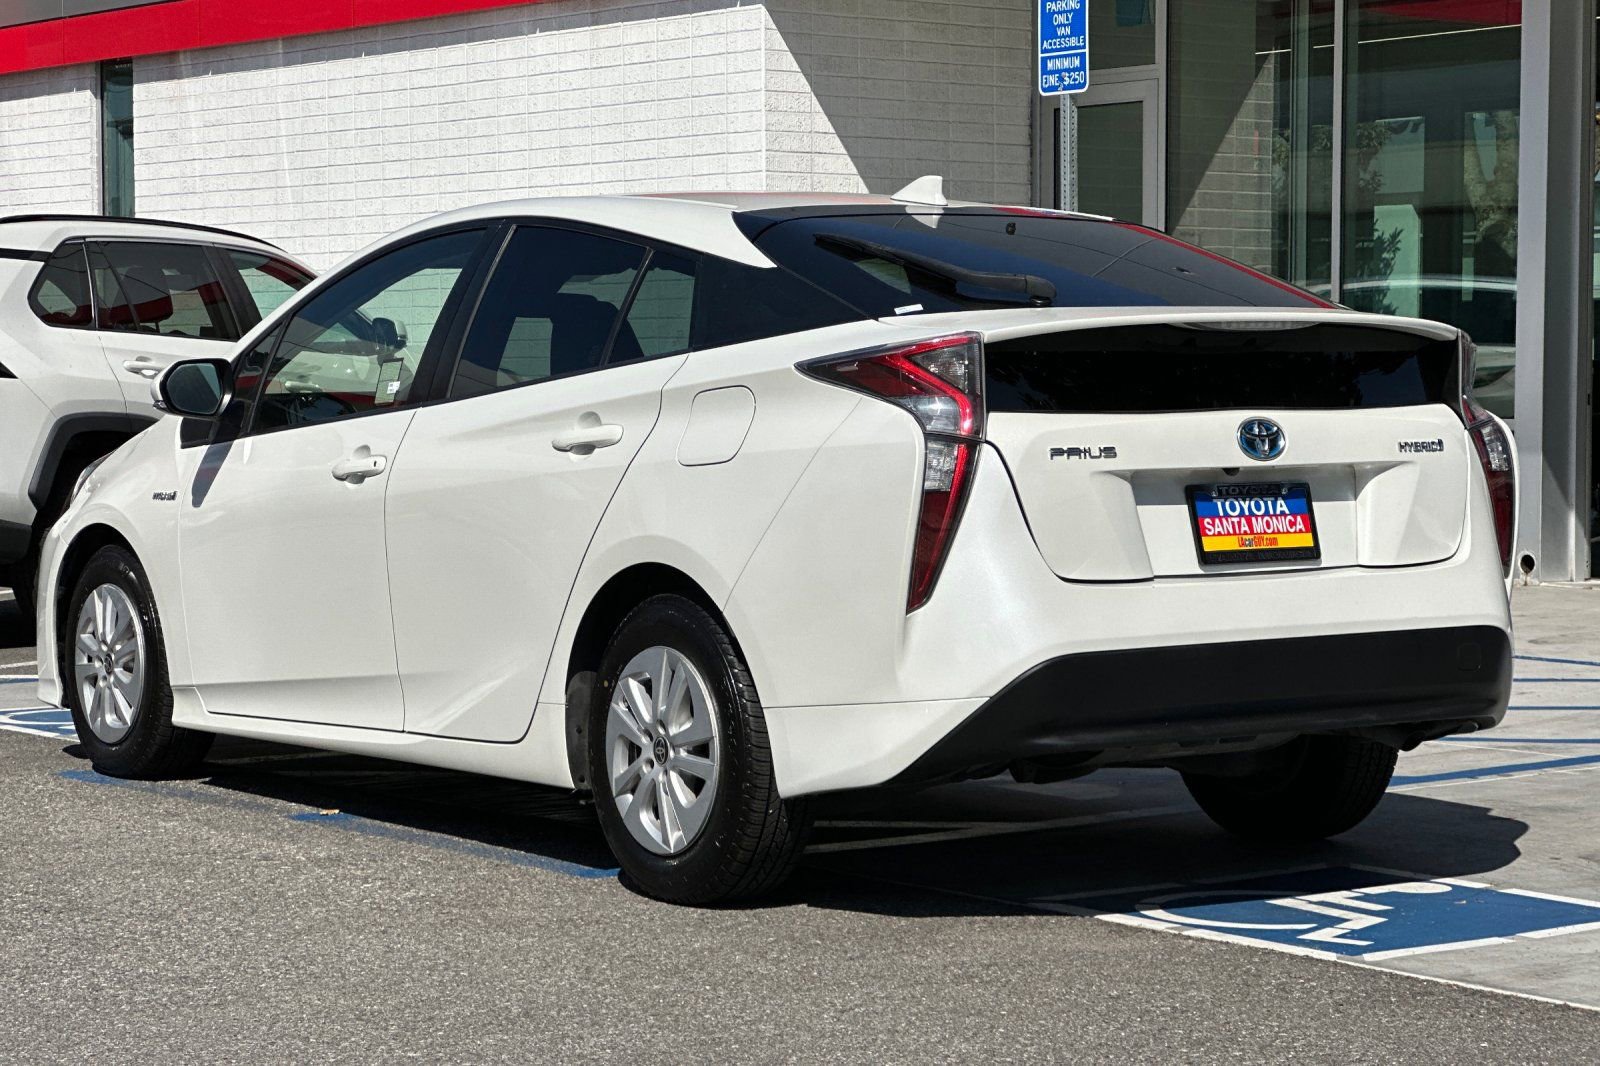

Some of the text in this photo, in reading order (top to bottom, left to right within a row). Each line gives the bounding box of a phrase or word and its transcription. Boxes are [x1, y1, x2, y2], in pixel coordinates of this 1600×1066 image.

[1046, 0, 1080, 13] PARKING
[1053, 12, 1073, 25] ONLY
[1056, 26, 1071, 36] VAN
[1042, 36, 1084, 49] ACCESSIBLE
[1047, 56, 1080, 71] MINIMUM
[1063, 71, 1085, 86] $250
[1049, 446, 1117, 460] PRIUS
[1219, 485, 1279, 496] TOYOTA
[1213, 496, 1290, 517] TOYOTA
[1204, 516, 1305, 535] SANTA MONICA
